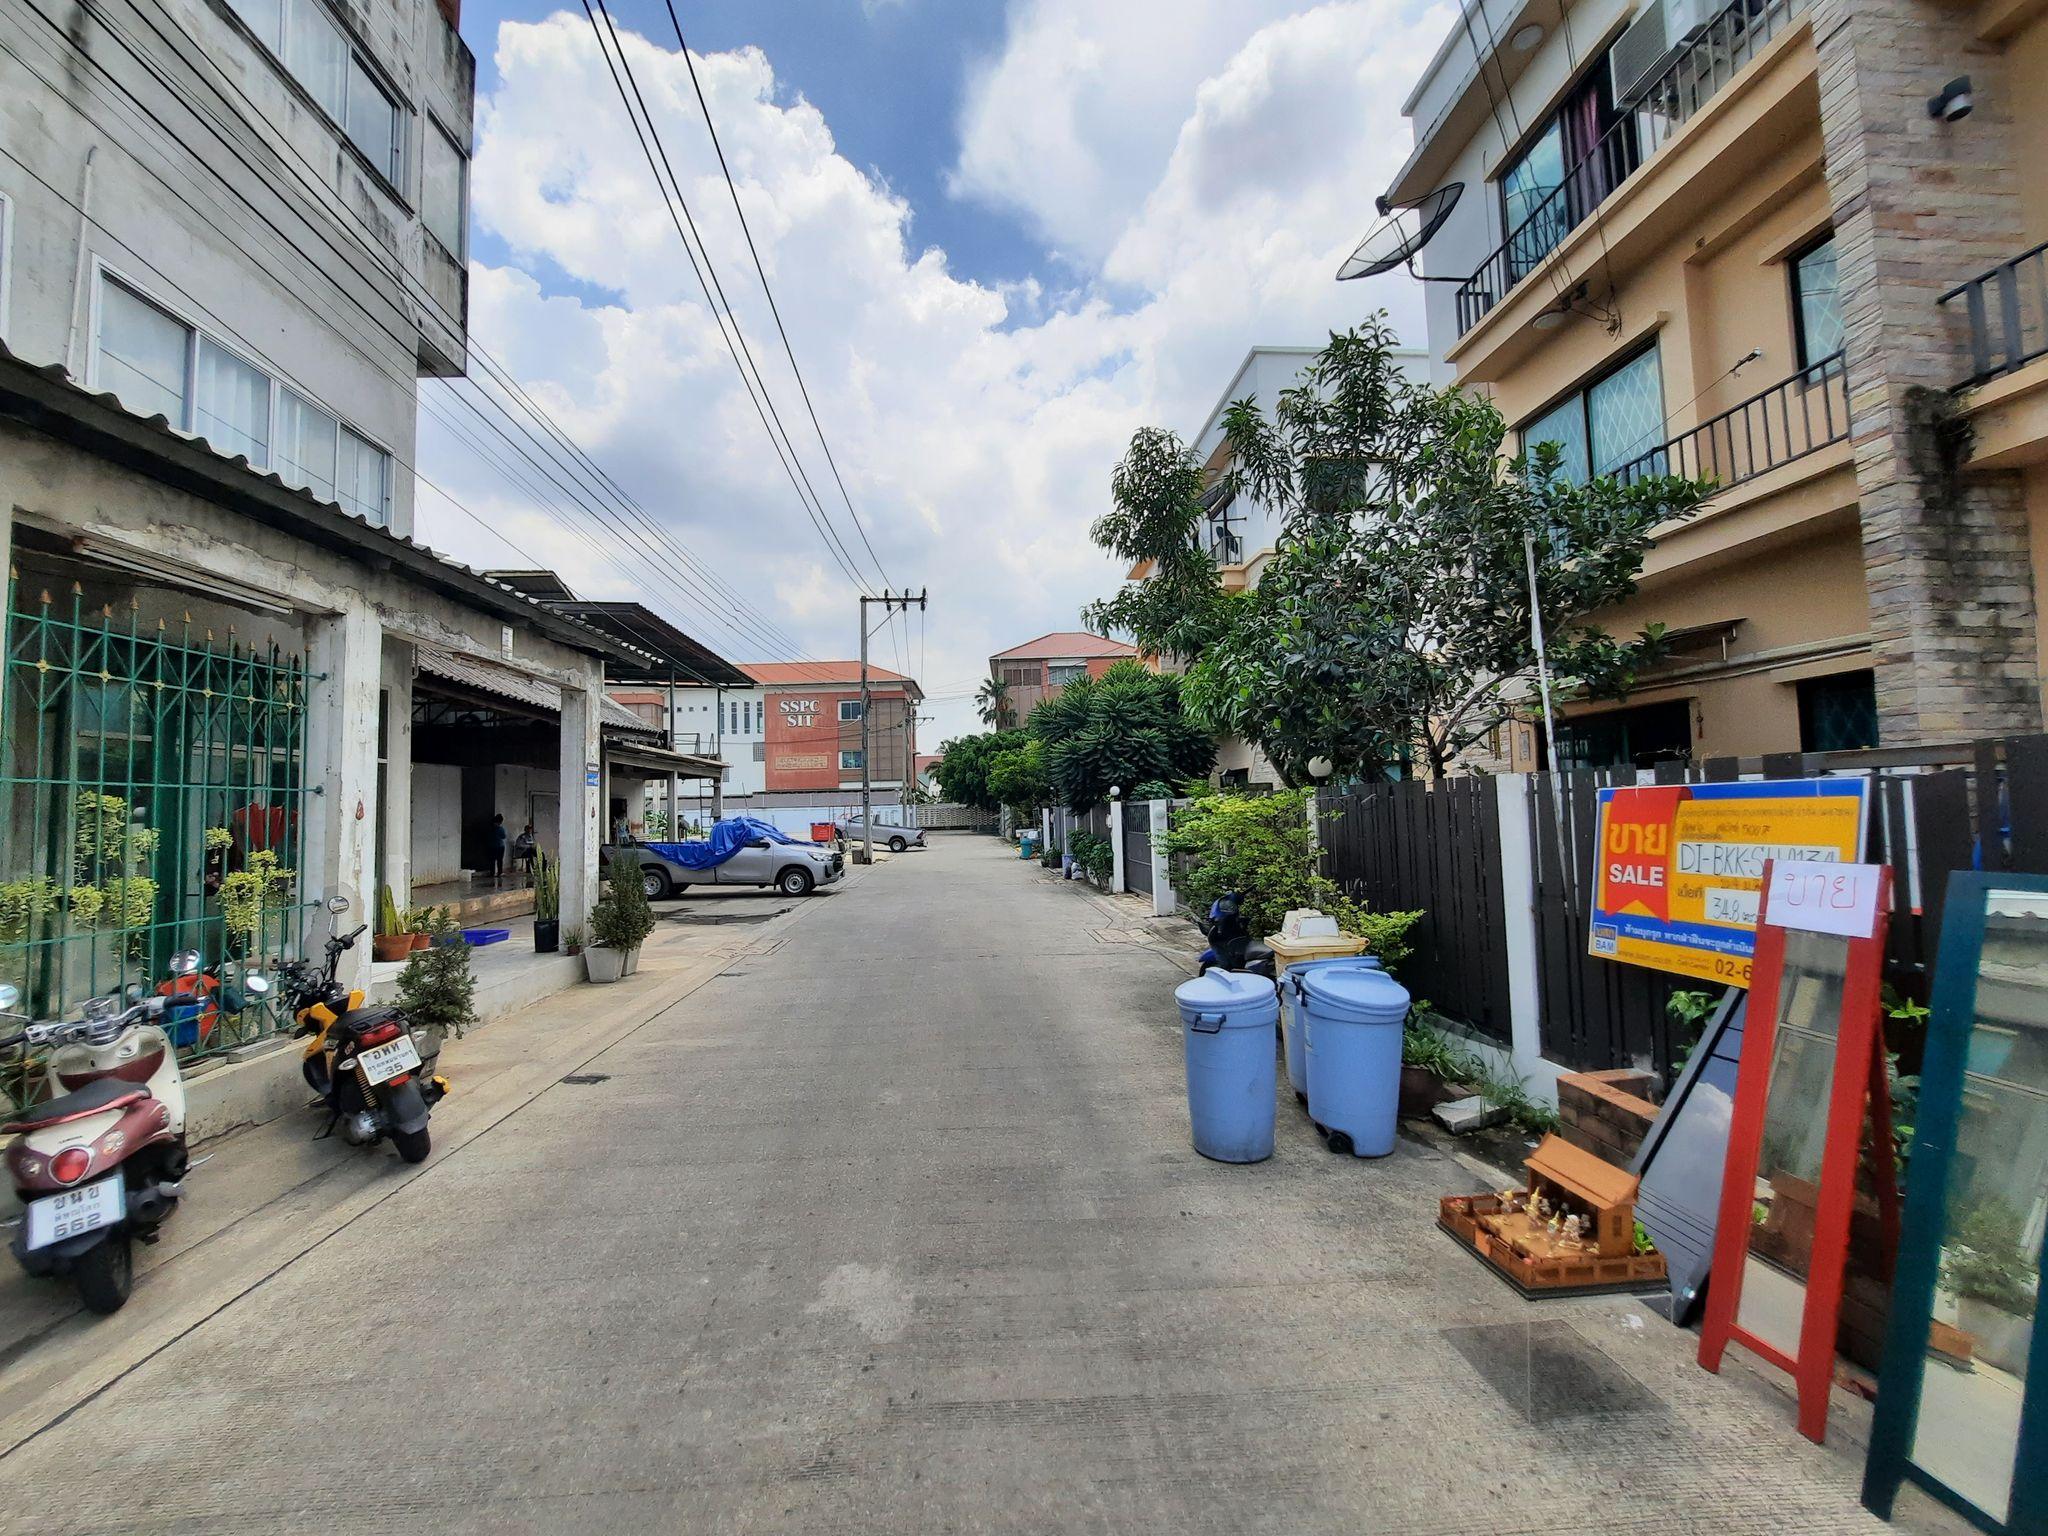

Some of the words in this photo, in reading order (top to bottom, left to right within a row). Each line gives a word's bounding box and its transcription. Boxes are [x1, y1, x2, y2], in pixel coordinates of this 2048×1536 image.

[780, 700, 820, 713] SSPC
[787, 714, 814, 727] SIT
[1609, 823, 1667, 856] ขาย
[1608, 863, 1664, 888] SALE
[1596, 940, 1614, 953] BAM
[385, 1061, 404, 1076] 35
[54, 1212, 102, 1238] 662
